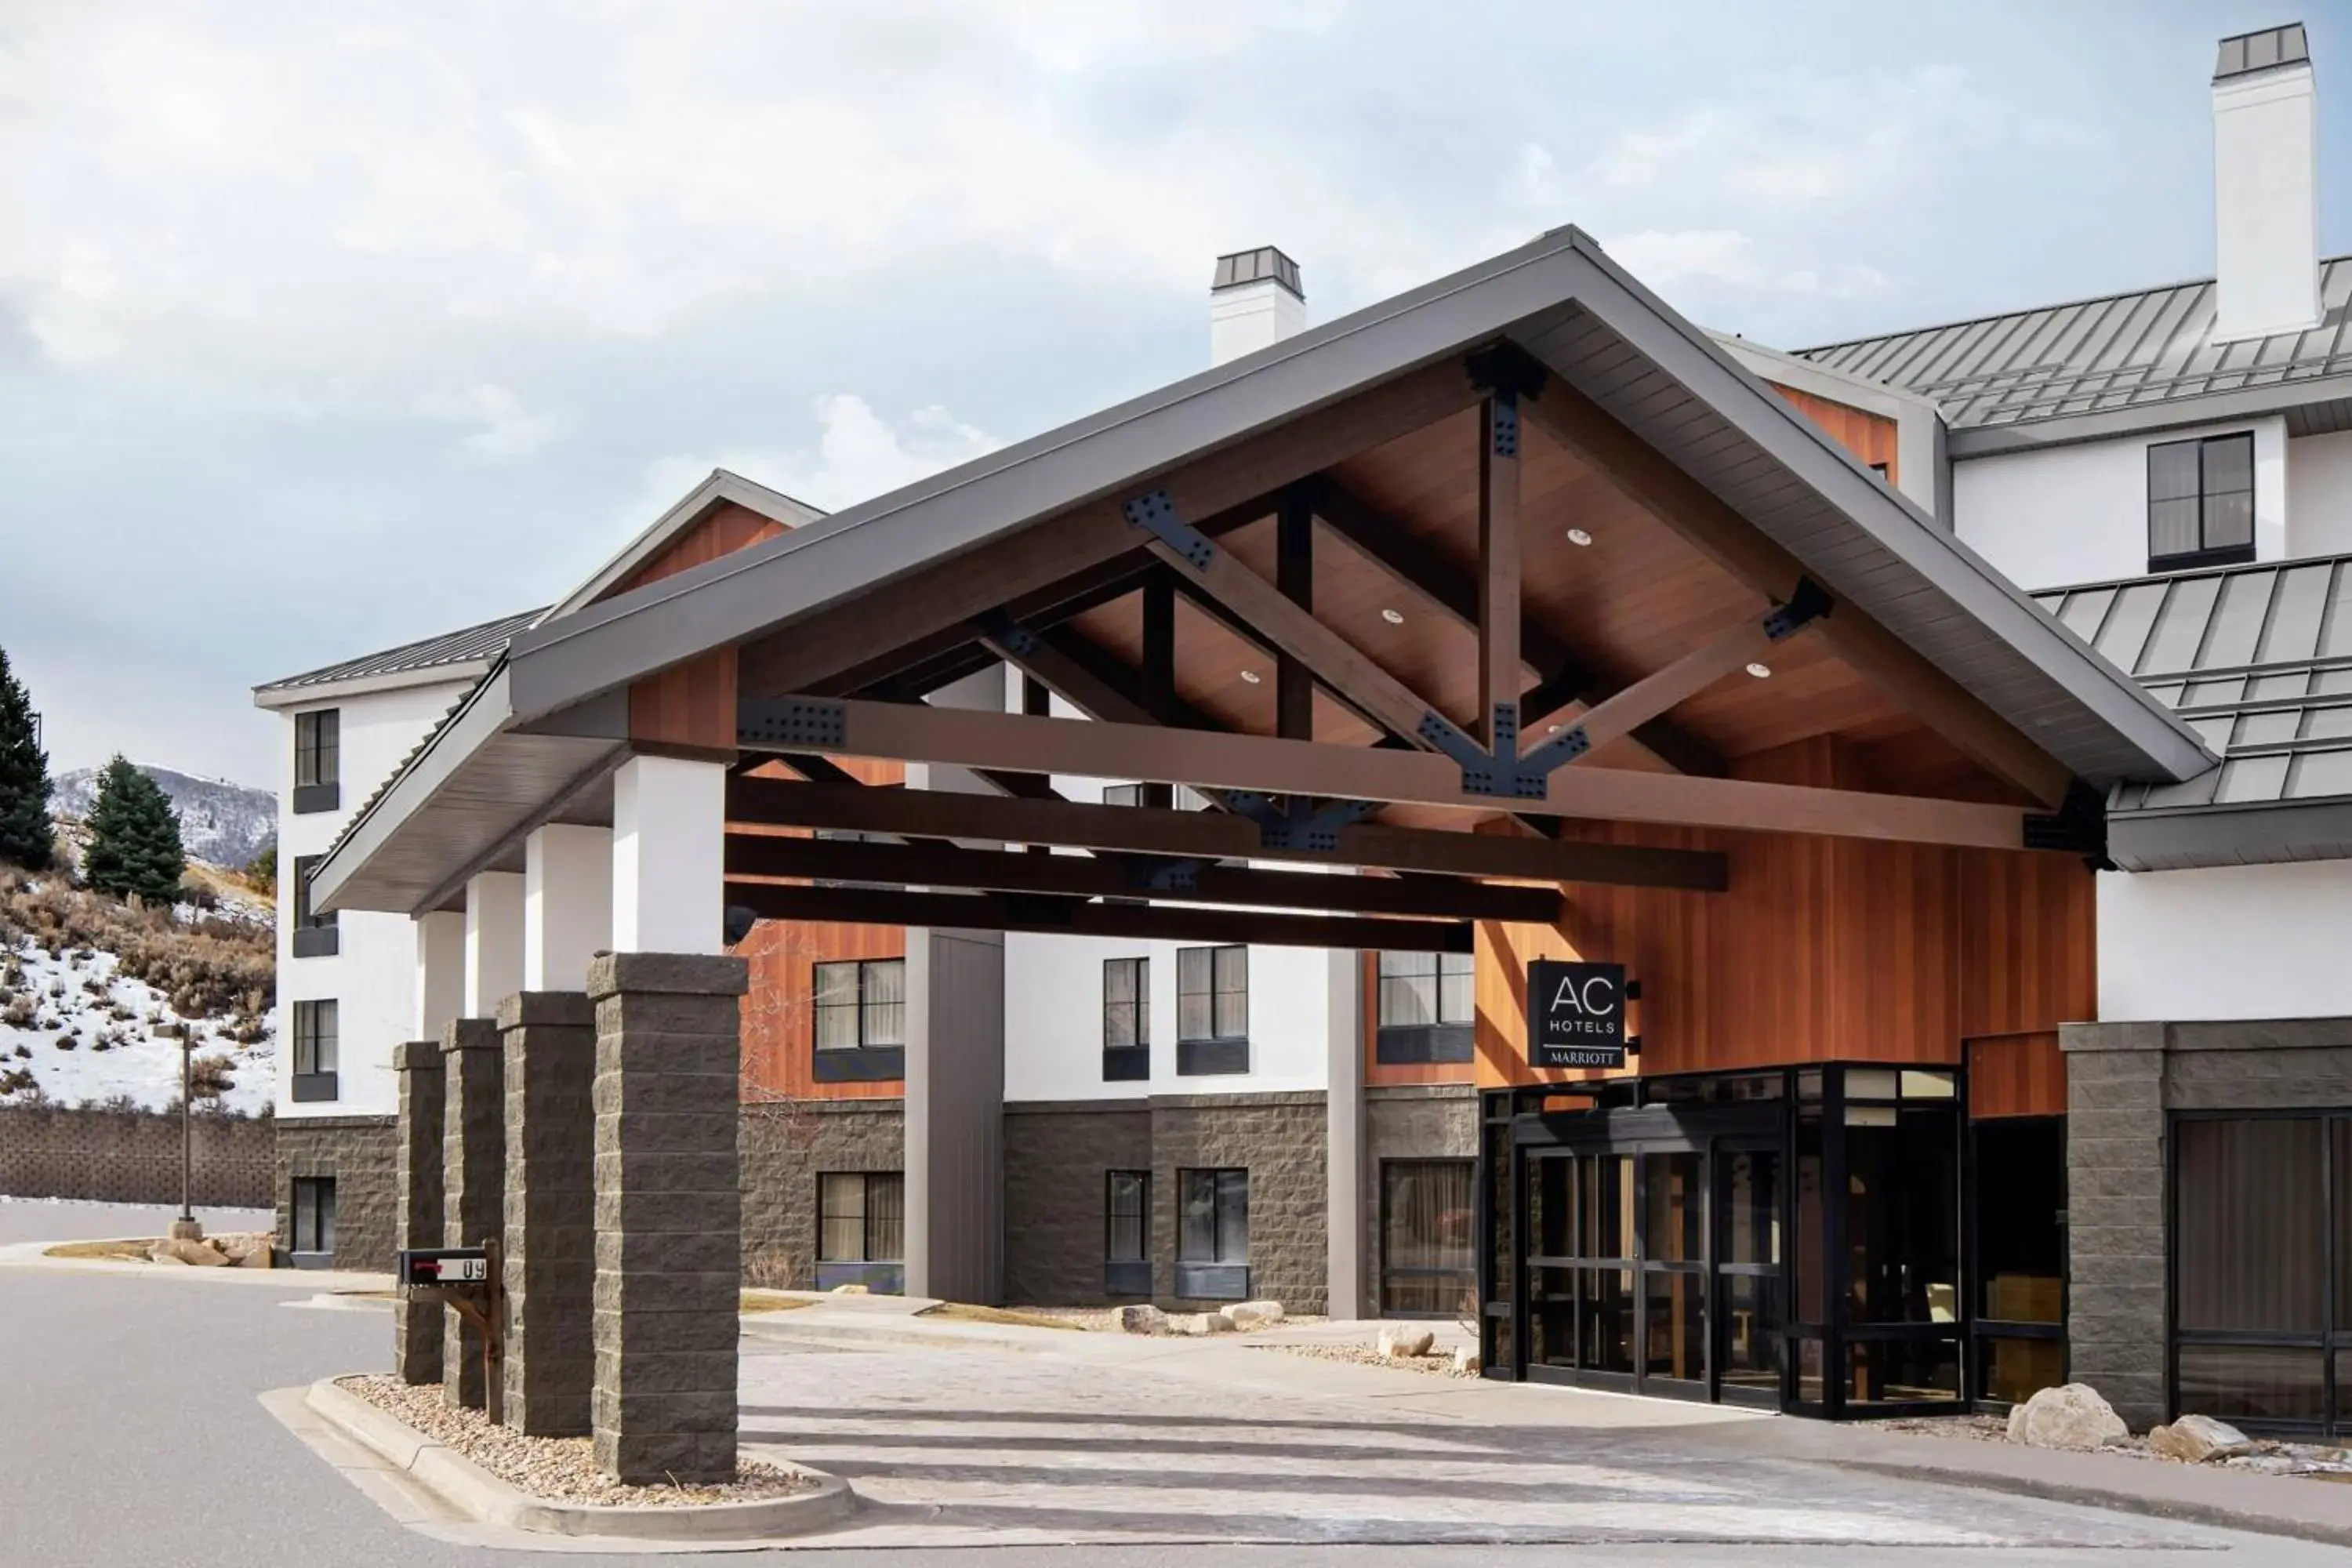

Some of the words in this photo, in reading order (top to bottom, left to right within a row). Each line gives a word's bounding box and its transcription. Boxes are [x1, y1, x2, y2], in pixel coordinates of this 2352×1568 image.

[1550, 976, 1614, 1015] AC
[1550, 1020, 1614, 1033] HOTELS
[1552, 1051, 1613, 1065] MARRIOTT
